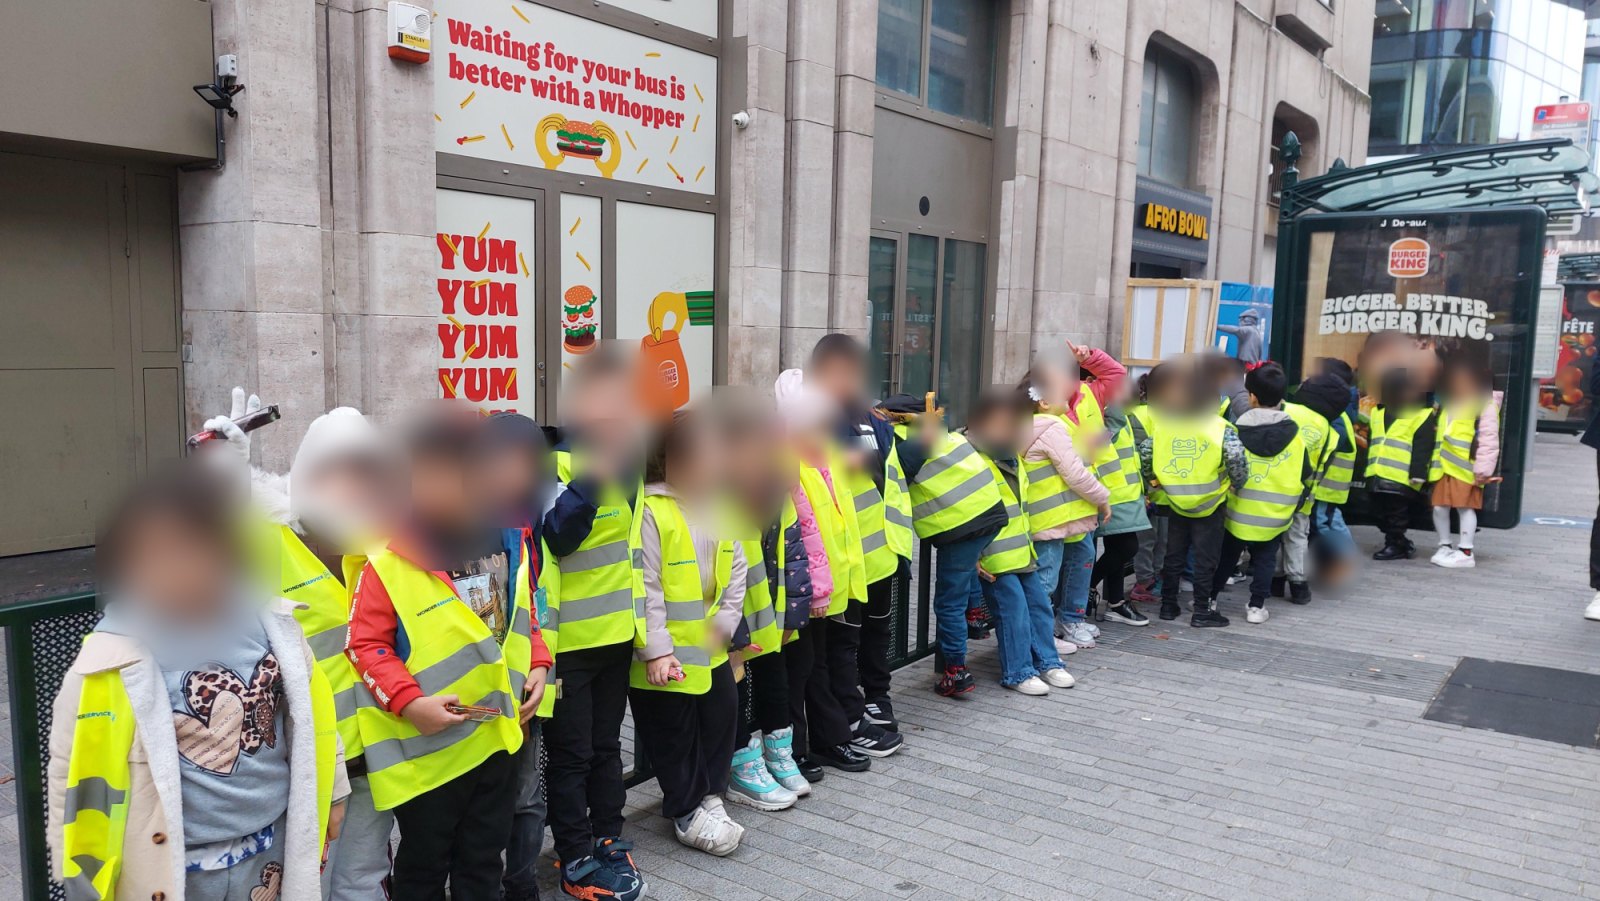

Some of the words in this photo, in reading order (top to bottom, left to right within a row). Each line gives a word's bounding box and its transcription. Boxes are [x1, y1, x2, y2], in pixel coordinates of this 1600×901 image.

[405, 34, 425, 43] STANLEY
[447, 18, 540, 71] Waiting
[544, 43, 578, 73] for
[582, 60, 631, 88] your
[634, 67, 667, 96] bus
[670, 76, 685, 101] is
[448, 53, 526, 94] better
[530, 75, 579, 106] with
[583, 91, 595, 110] a
[599, 89, 685, 130] Whopper
[1145, 202, 1177, 233] AFRO
[1178, 210, 1209, 240] BOWL
[436, 233, 518, 274] YUM
[1390, 258, 1426, 269] KING
[1391, 250, 1428, 258] BURGER
[437, 279, 518, 317] YUM
[1320, 293, 1402, 315] BIGGER.
[1406, 293, 1495, 319] BETTER.
[1318, 311, 1418, 335] BURGER
[1420, 312, 1494, 341] KING.
[1563, 317, 1594, 333] FÊTE
[438, 324, 518, 360] YUM
[439, 368, 518, 402] YUM
[76, 711, 111, 720] ERSERVICE
